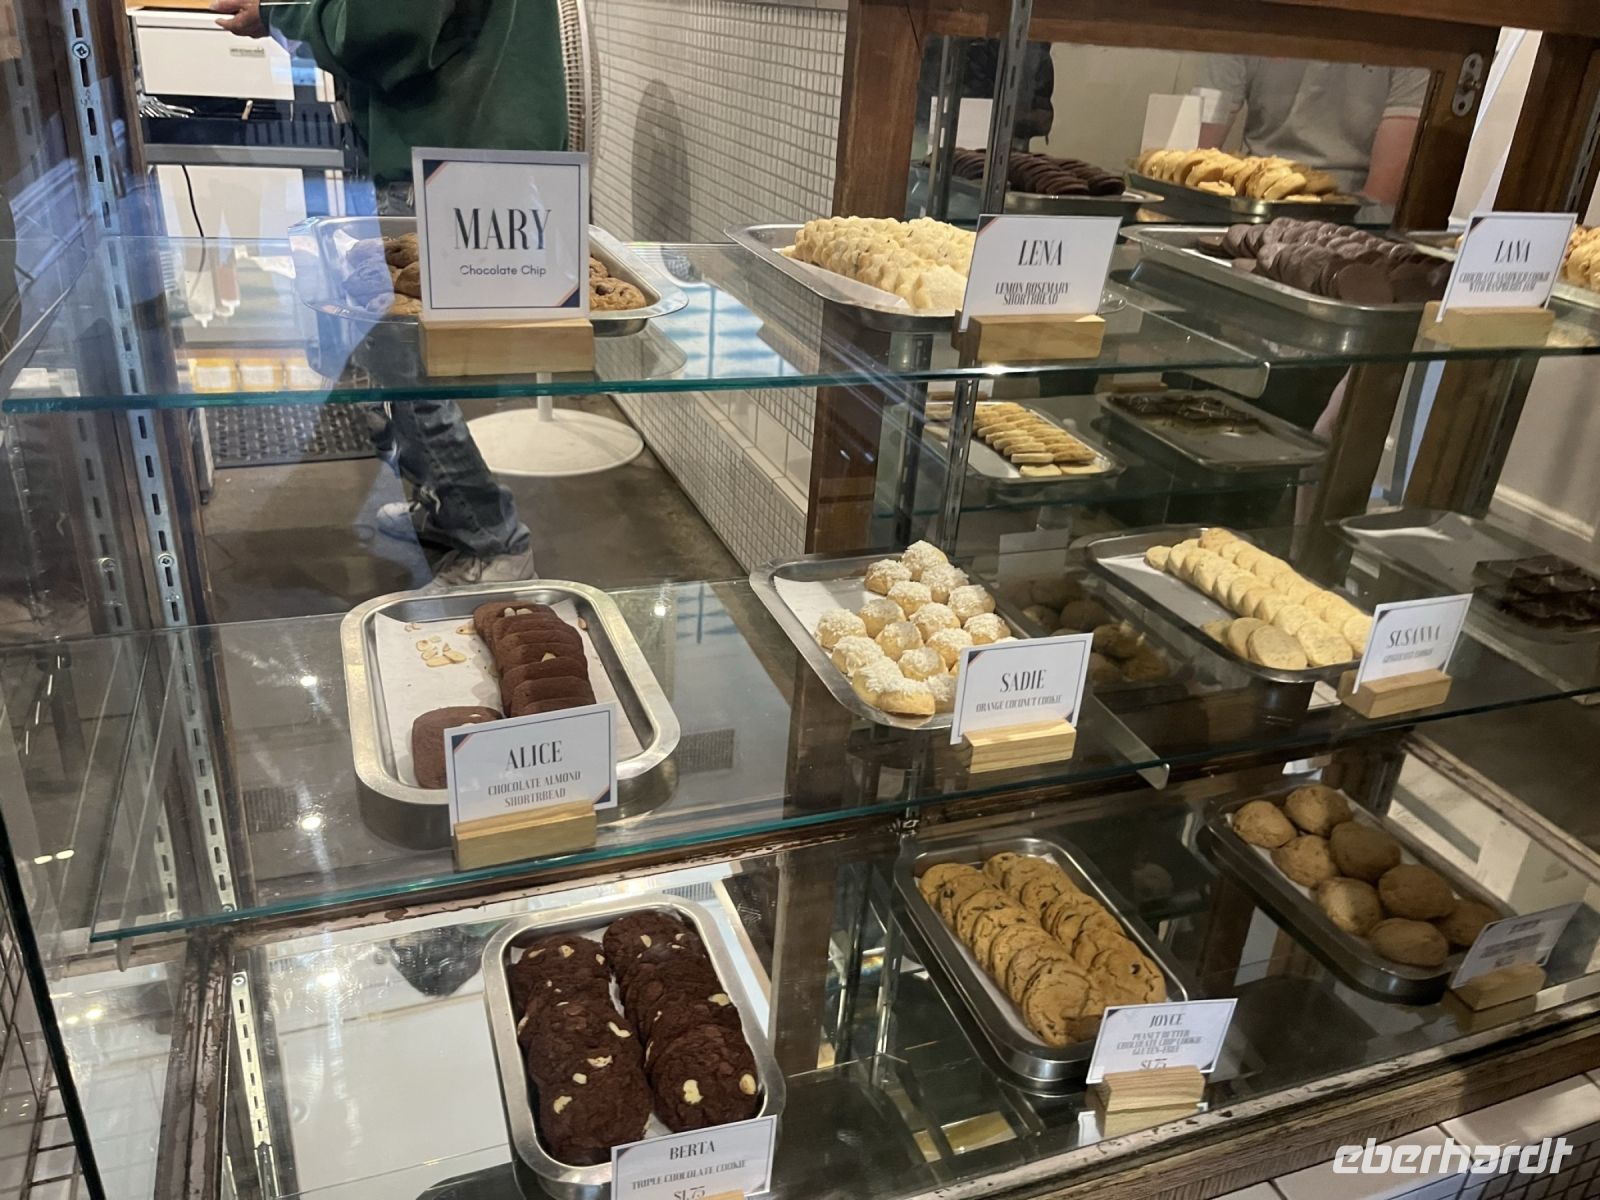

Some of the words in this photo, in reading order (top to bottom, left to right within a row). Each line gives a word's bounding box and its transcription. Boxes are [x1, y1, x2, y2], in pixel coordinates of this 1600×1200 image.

[453, 207, 552, 250] MARY
[1018, 239, 1063, 266] LENA
[459, 264, 518, 276] Chocolate
[521, 264, 547, 278] Chip
[994, 281, 1024, 295] LEMON
[1025, 281, 1070, 295] ROSEMARY
[1002, 292, 1059, 306] SHORTBREAD
[1000, 669, 1047, 693] SADIE
[505, 740, 563, 771] ALICE
[488, 777, 542, 796] CHOCOLATE
[543, 770, 582, 788] ALMOND
[1149, 1013, 1185, 1028] JOYCE
[669, 1140, 715, 1160] BERTA
[632, 1175, 664, 1190] TRIPLE
[664, 1167, 714, 1183] CHOCOLATE
[716, 1159, 747, 1173] COOKIE
